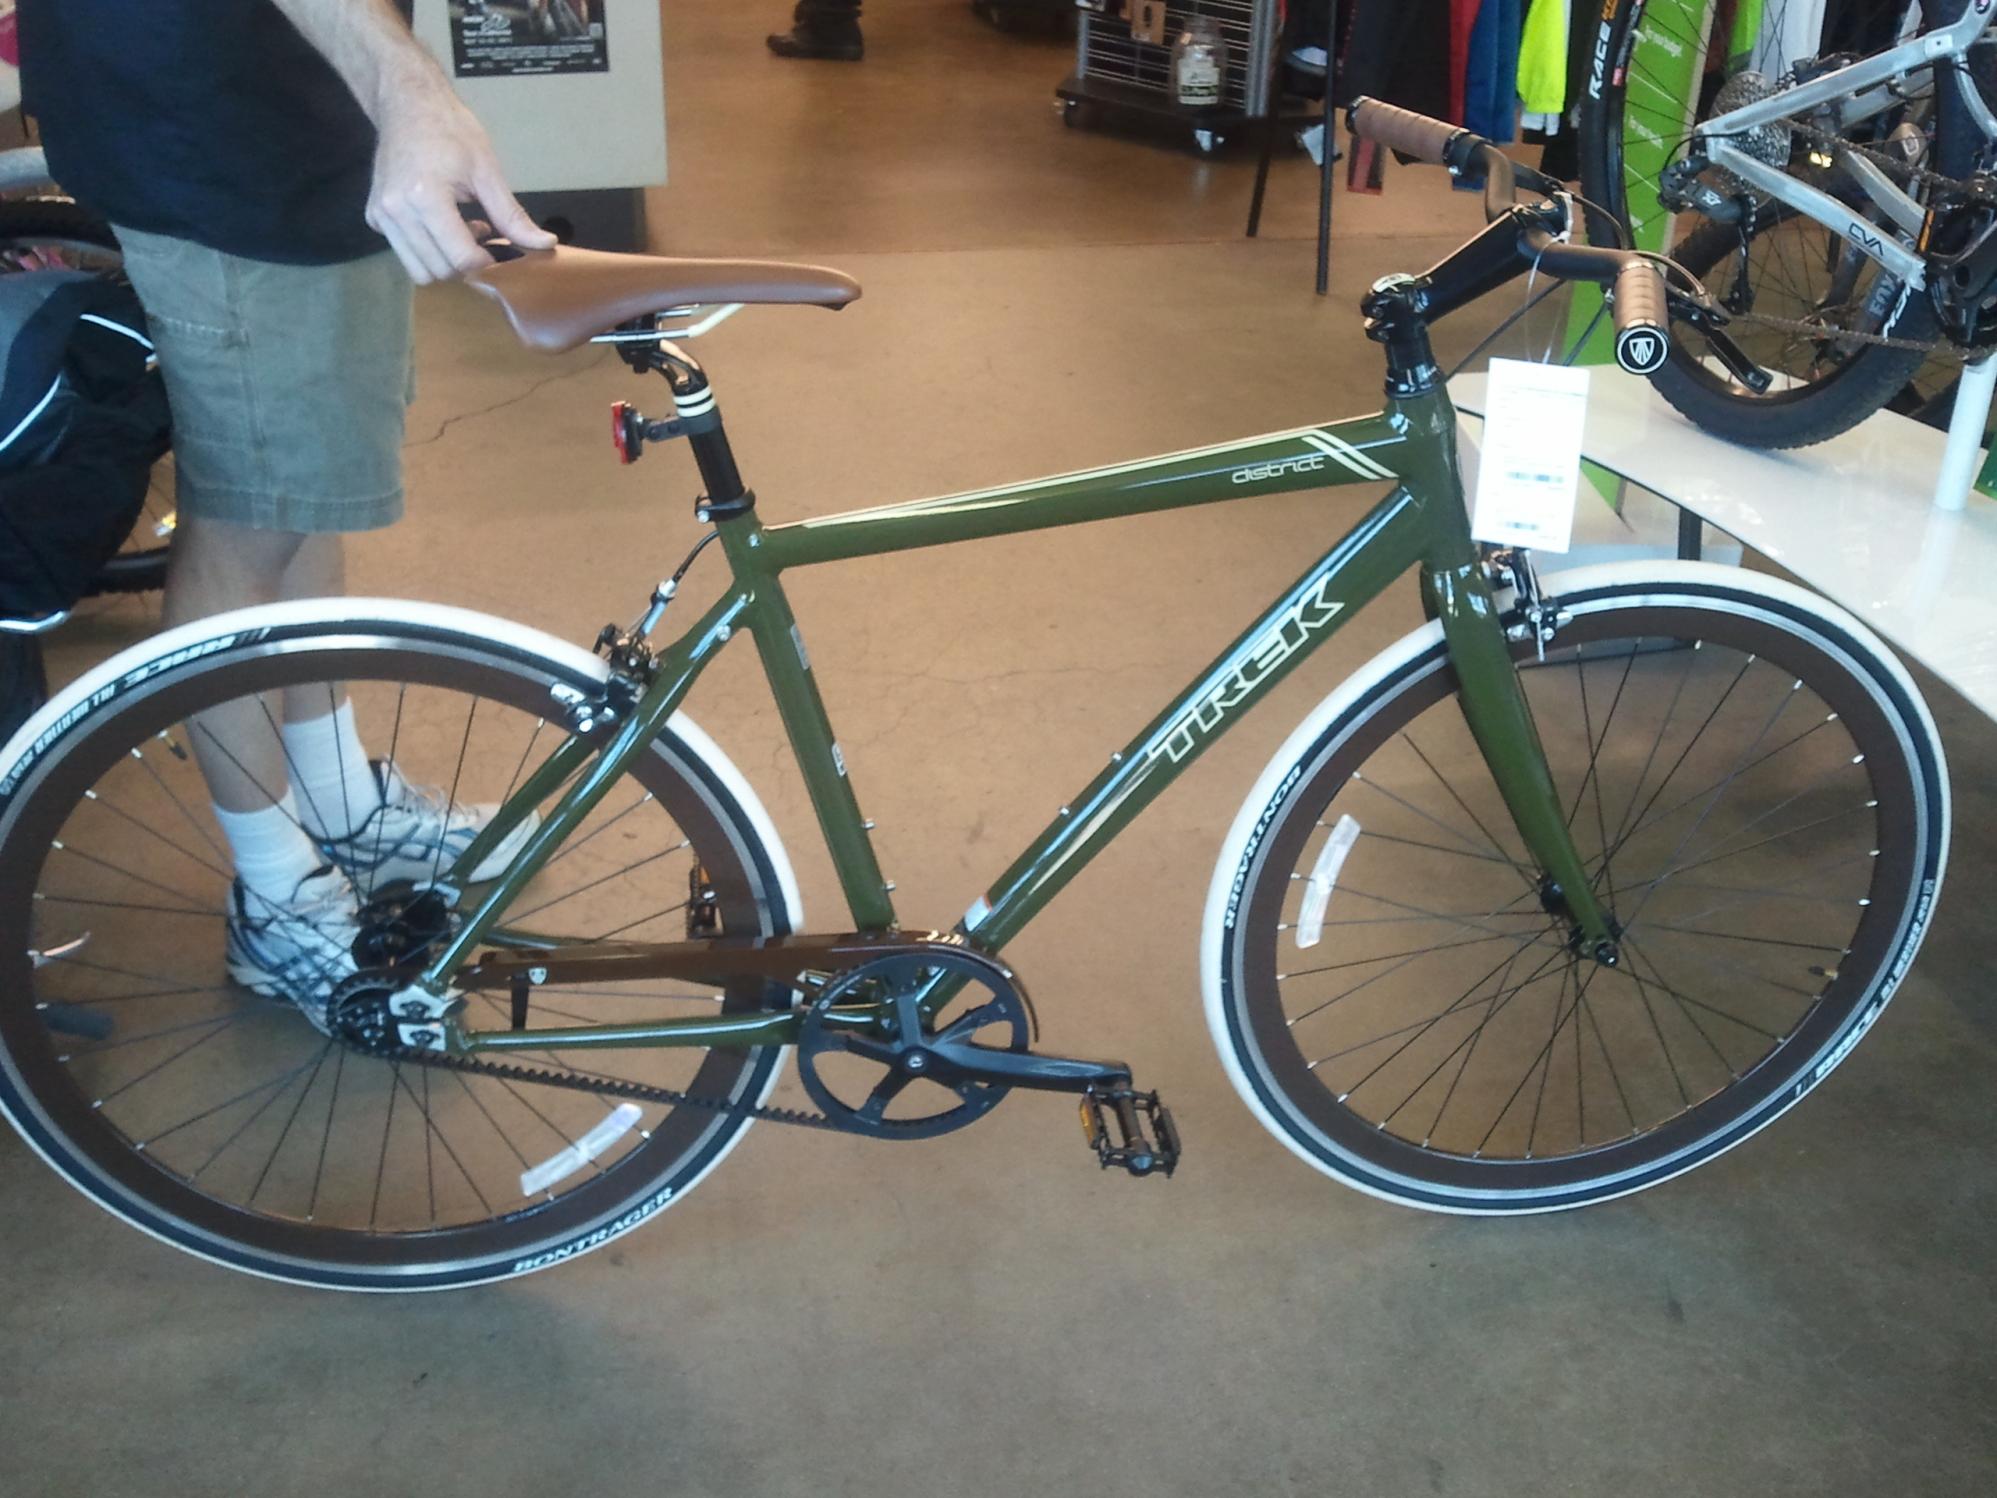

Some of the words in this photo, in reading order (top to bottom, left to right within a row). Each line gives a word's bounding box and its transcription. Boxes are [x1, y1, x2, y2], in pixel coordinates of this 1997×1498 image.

[1589, 21, 1611, 99] RACE
[1231, 456, 1325, 484] district
[1147, 571, 1345, 763] TREK
[1224, 765, 1301, 930] BONTRAGER
[513, 1187, 673, 1273] BONTRAGER
